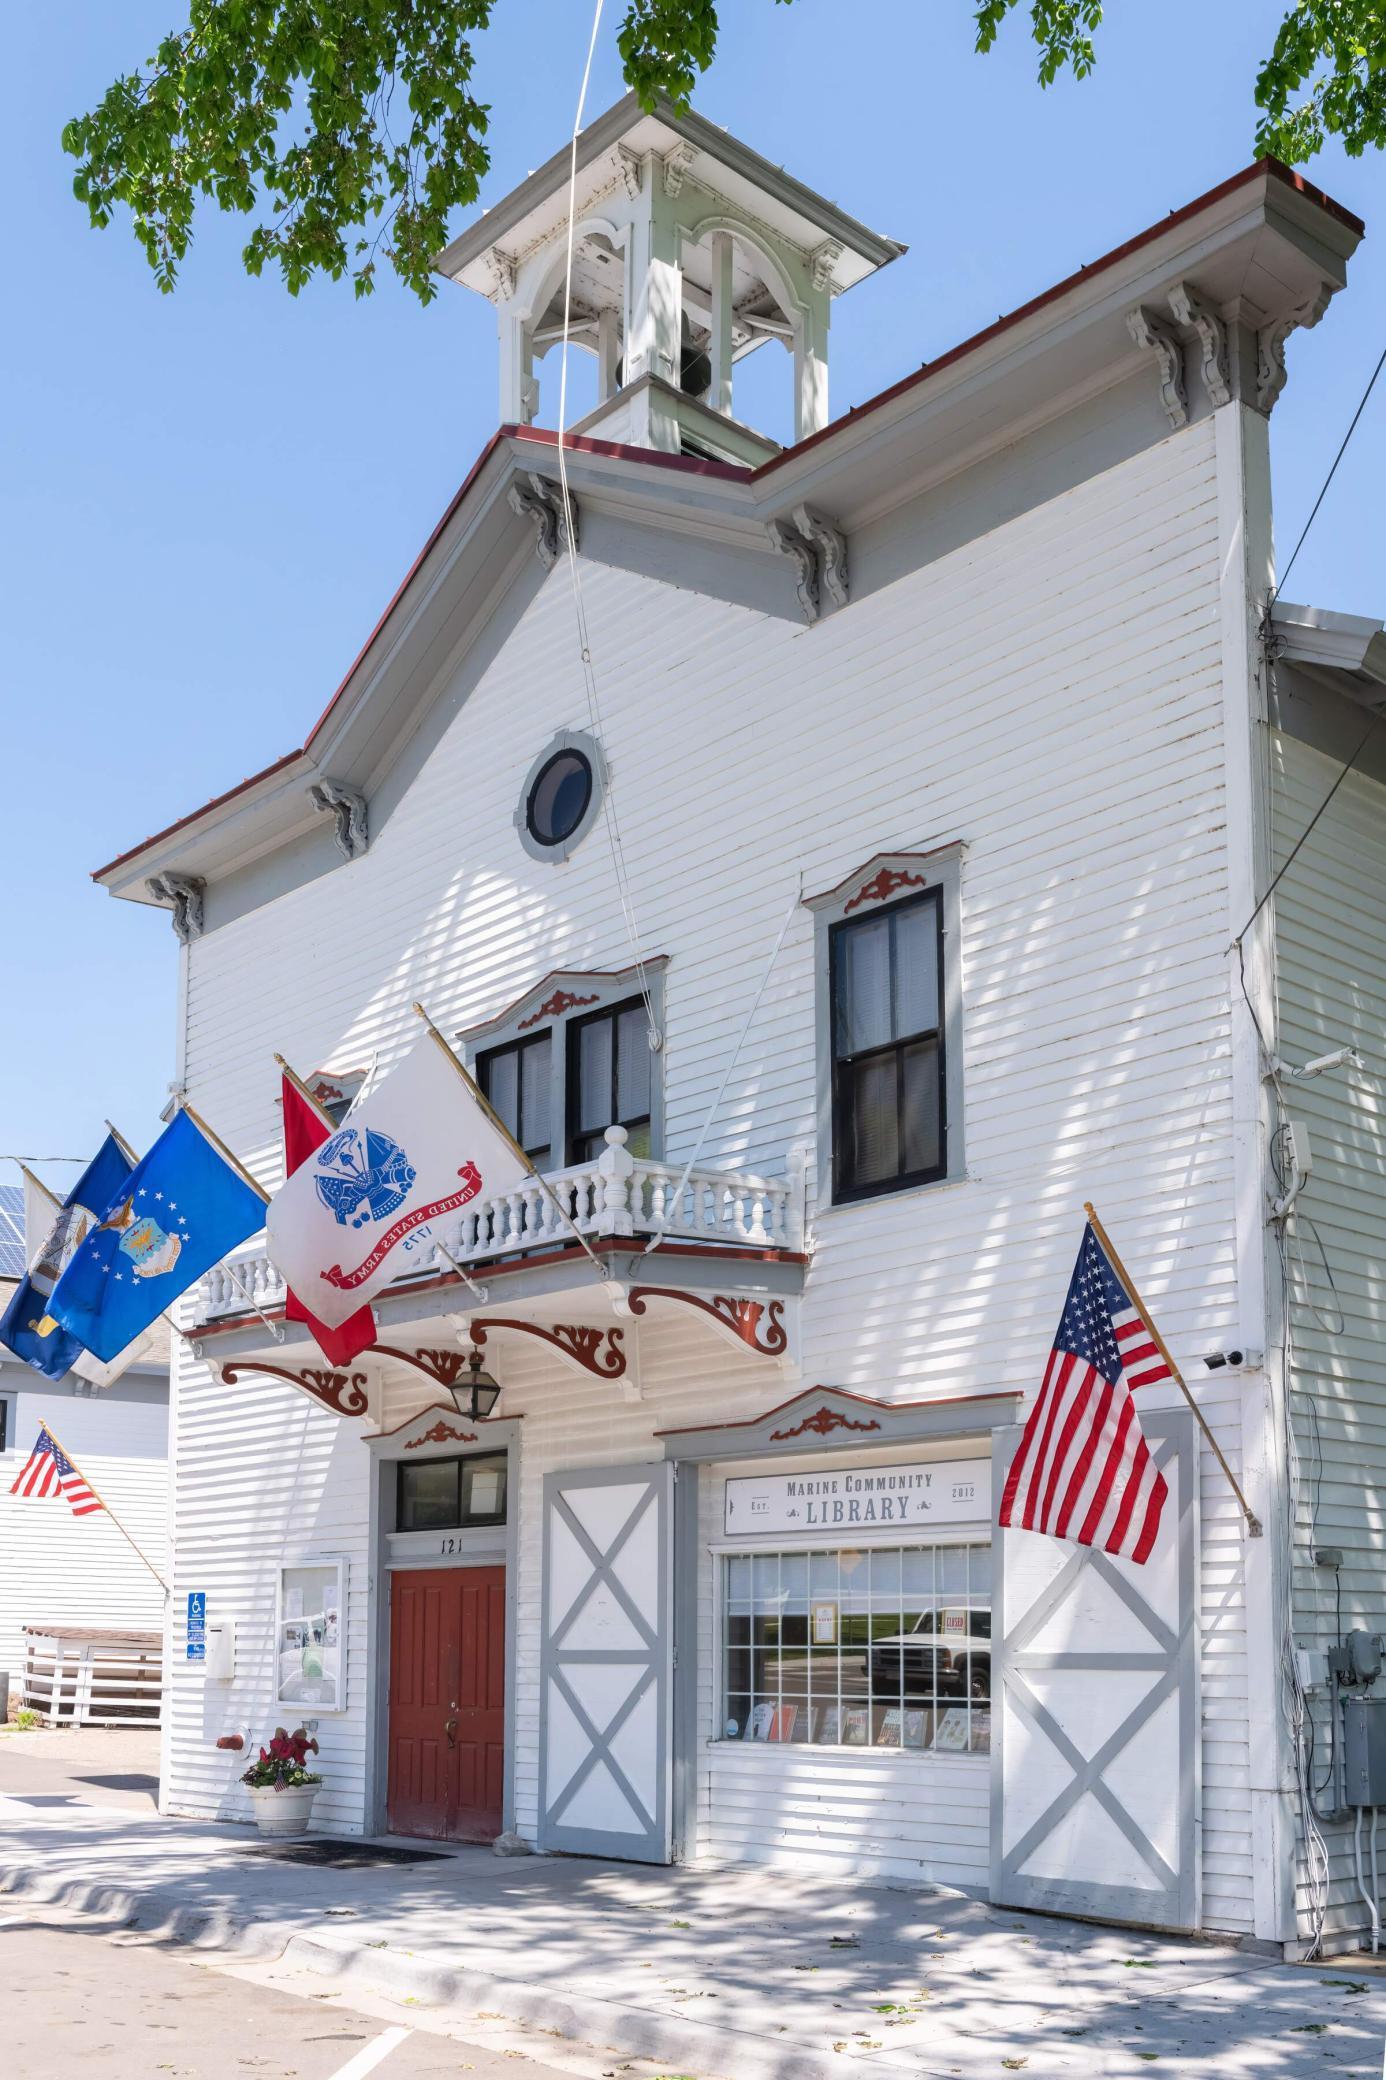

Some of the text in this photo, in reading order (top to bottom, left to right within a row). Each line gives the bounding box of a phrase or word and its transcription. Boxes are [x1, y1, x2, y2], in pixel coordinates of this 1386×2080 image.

[952, 1487, 975, 1498] 2012
[806, 1496, 909, 1524] LIBRARY
[441, 1538, 462, 1554] 121
[946, 1617, 964, 1628] CLOSED
